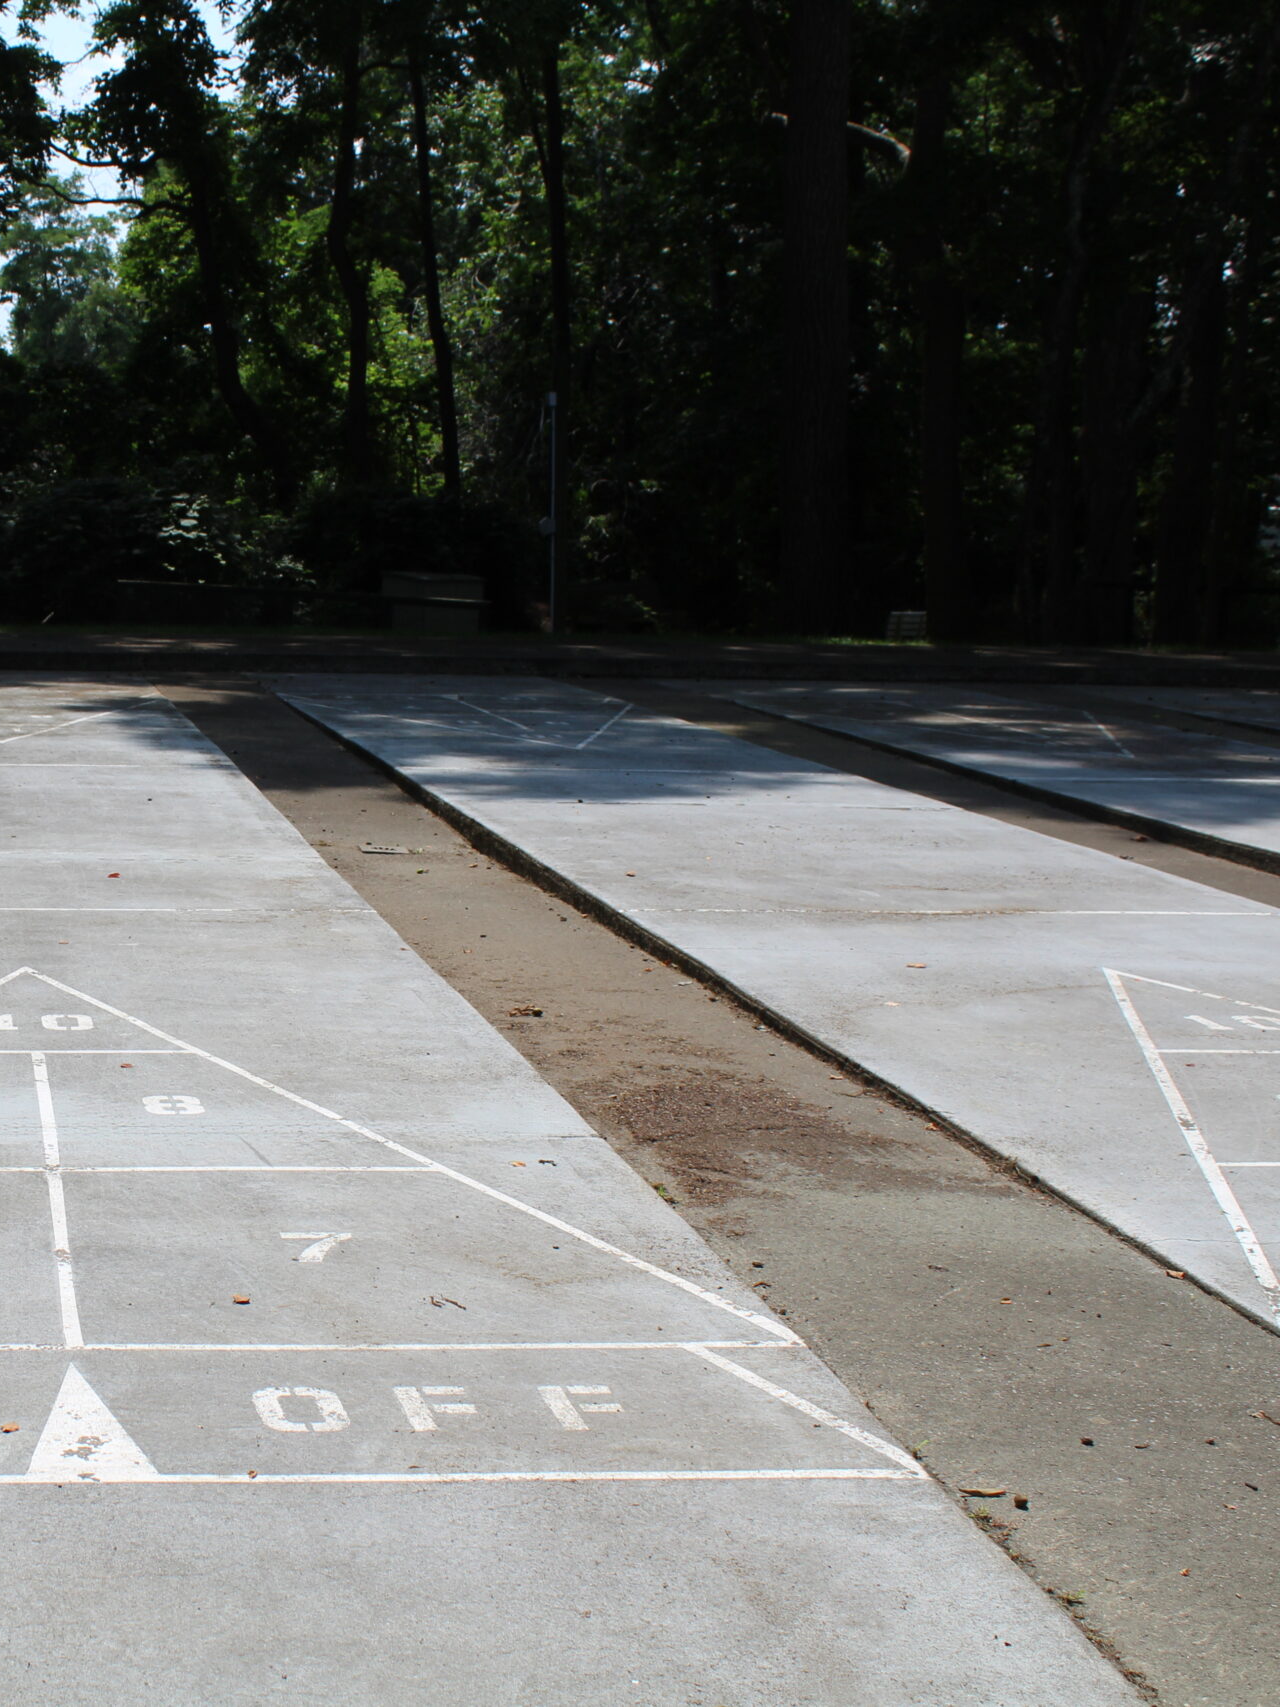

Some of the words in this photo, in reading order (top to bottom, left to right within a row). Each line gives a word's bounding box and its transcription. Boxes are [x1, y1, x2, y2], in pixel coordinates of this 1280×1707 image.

[142, 1095, 205, 1115] 8
[279, 1231, 352, 1263] 7
[252, 1385, 623, 1431] OFF
